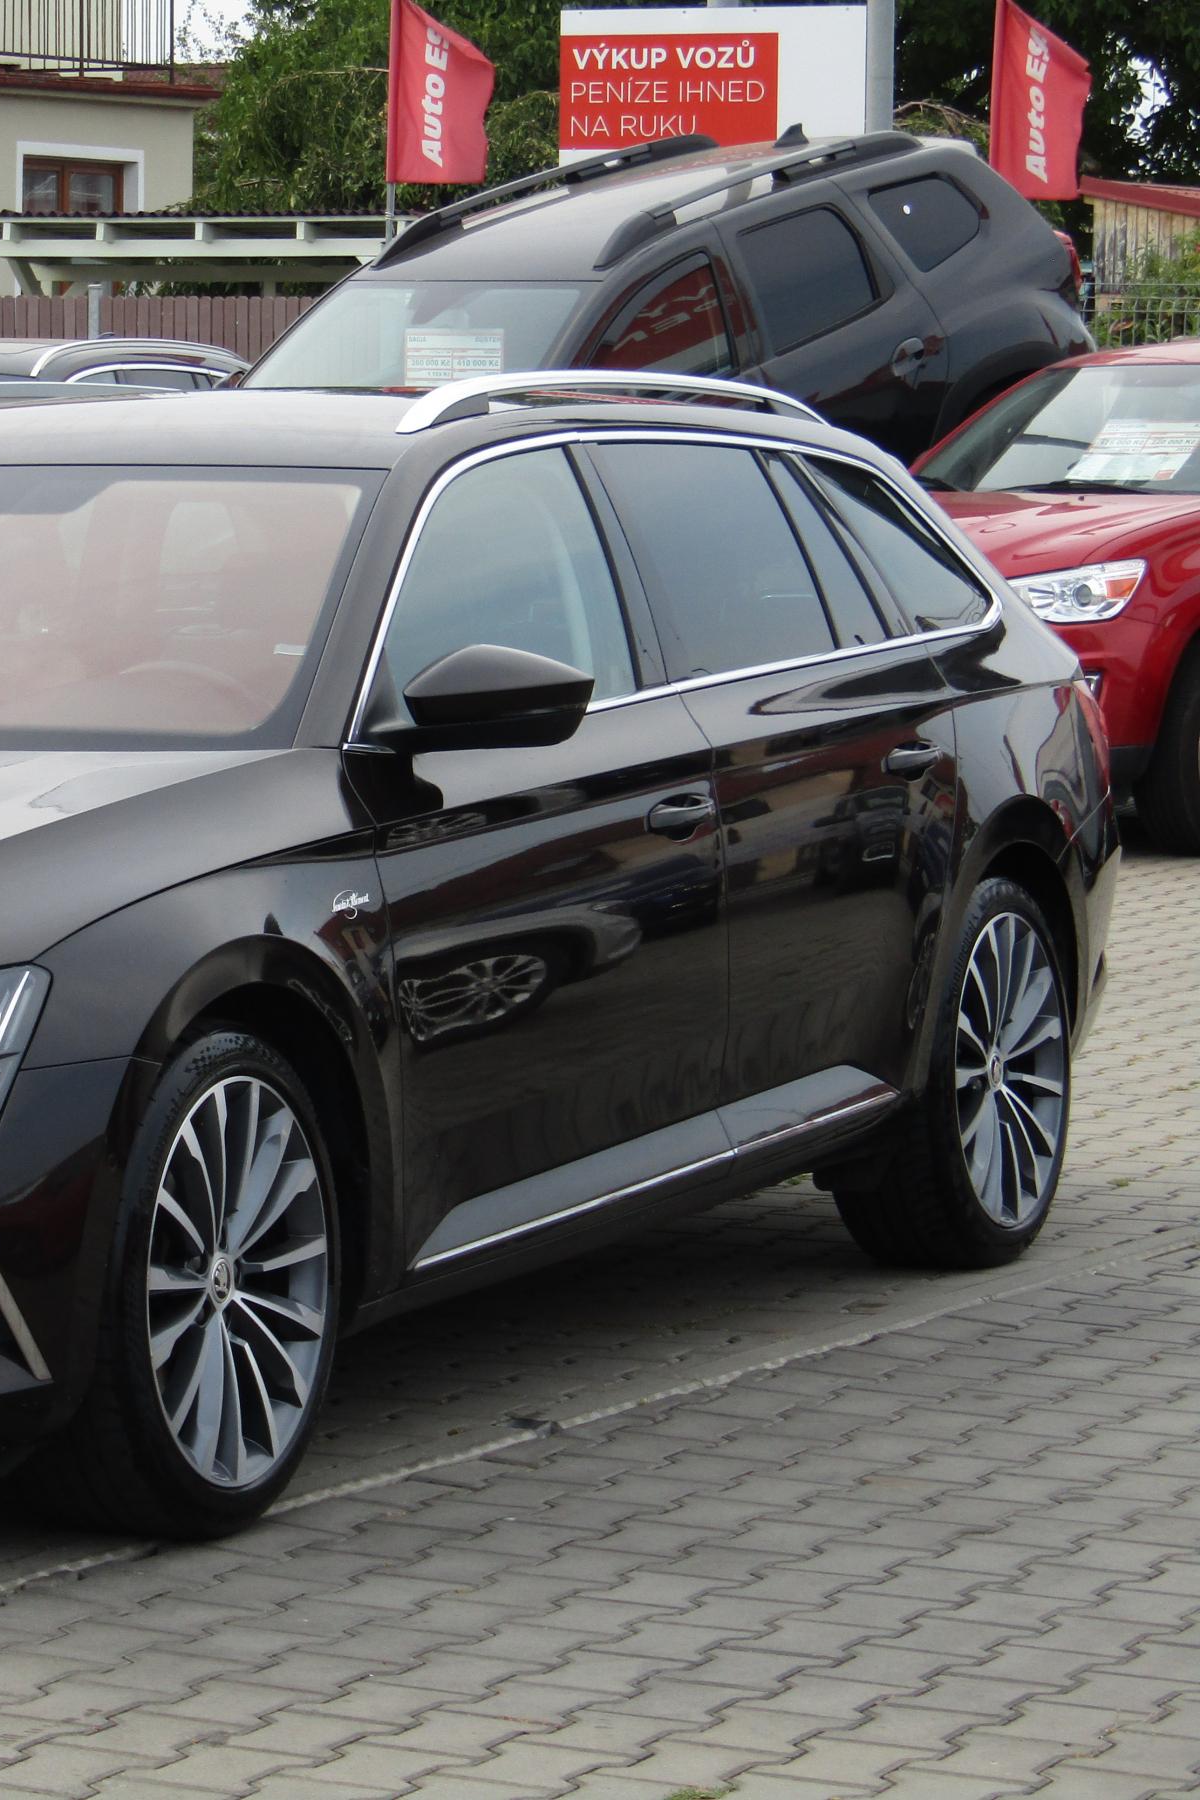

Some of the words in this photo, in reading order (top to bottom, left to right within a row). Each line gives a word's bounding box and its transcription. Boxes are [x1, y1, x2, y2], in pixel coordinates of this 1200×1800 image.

[572, 43, 667, 70] VÝKUP
[676, 39, 755, 69] VOZŮ
[571, 76, 668, 104] PENÍZE
[679, 80, 765, 103] IHNED
[421, 73, 446, 168] Auto
[570, 115, 610, 137] NA
[620, 114, 696, 137] RUKU
[1025, 86, 1048, 183] Auto
